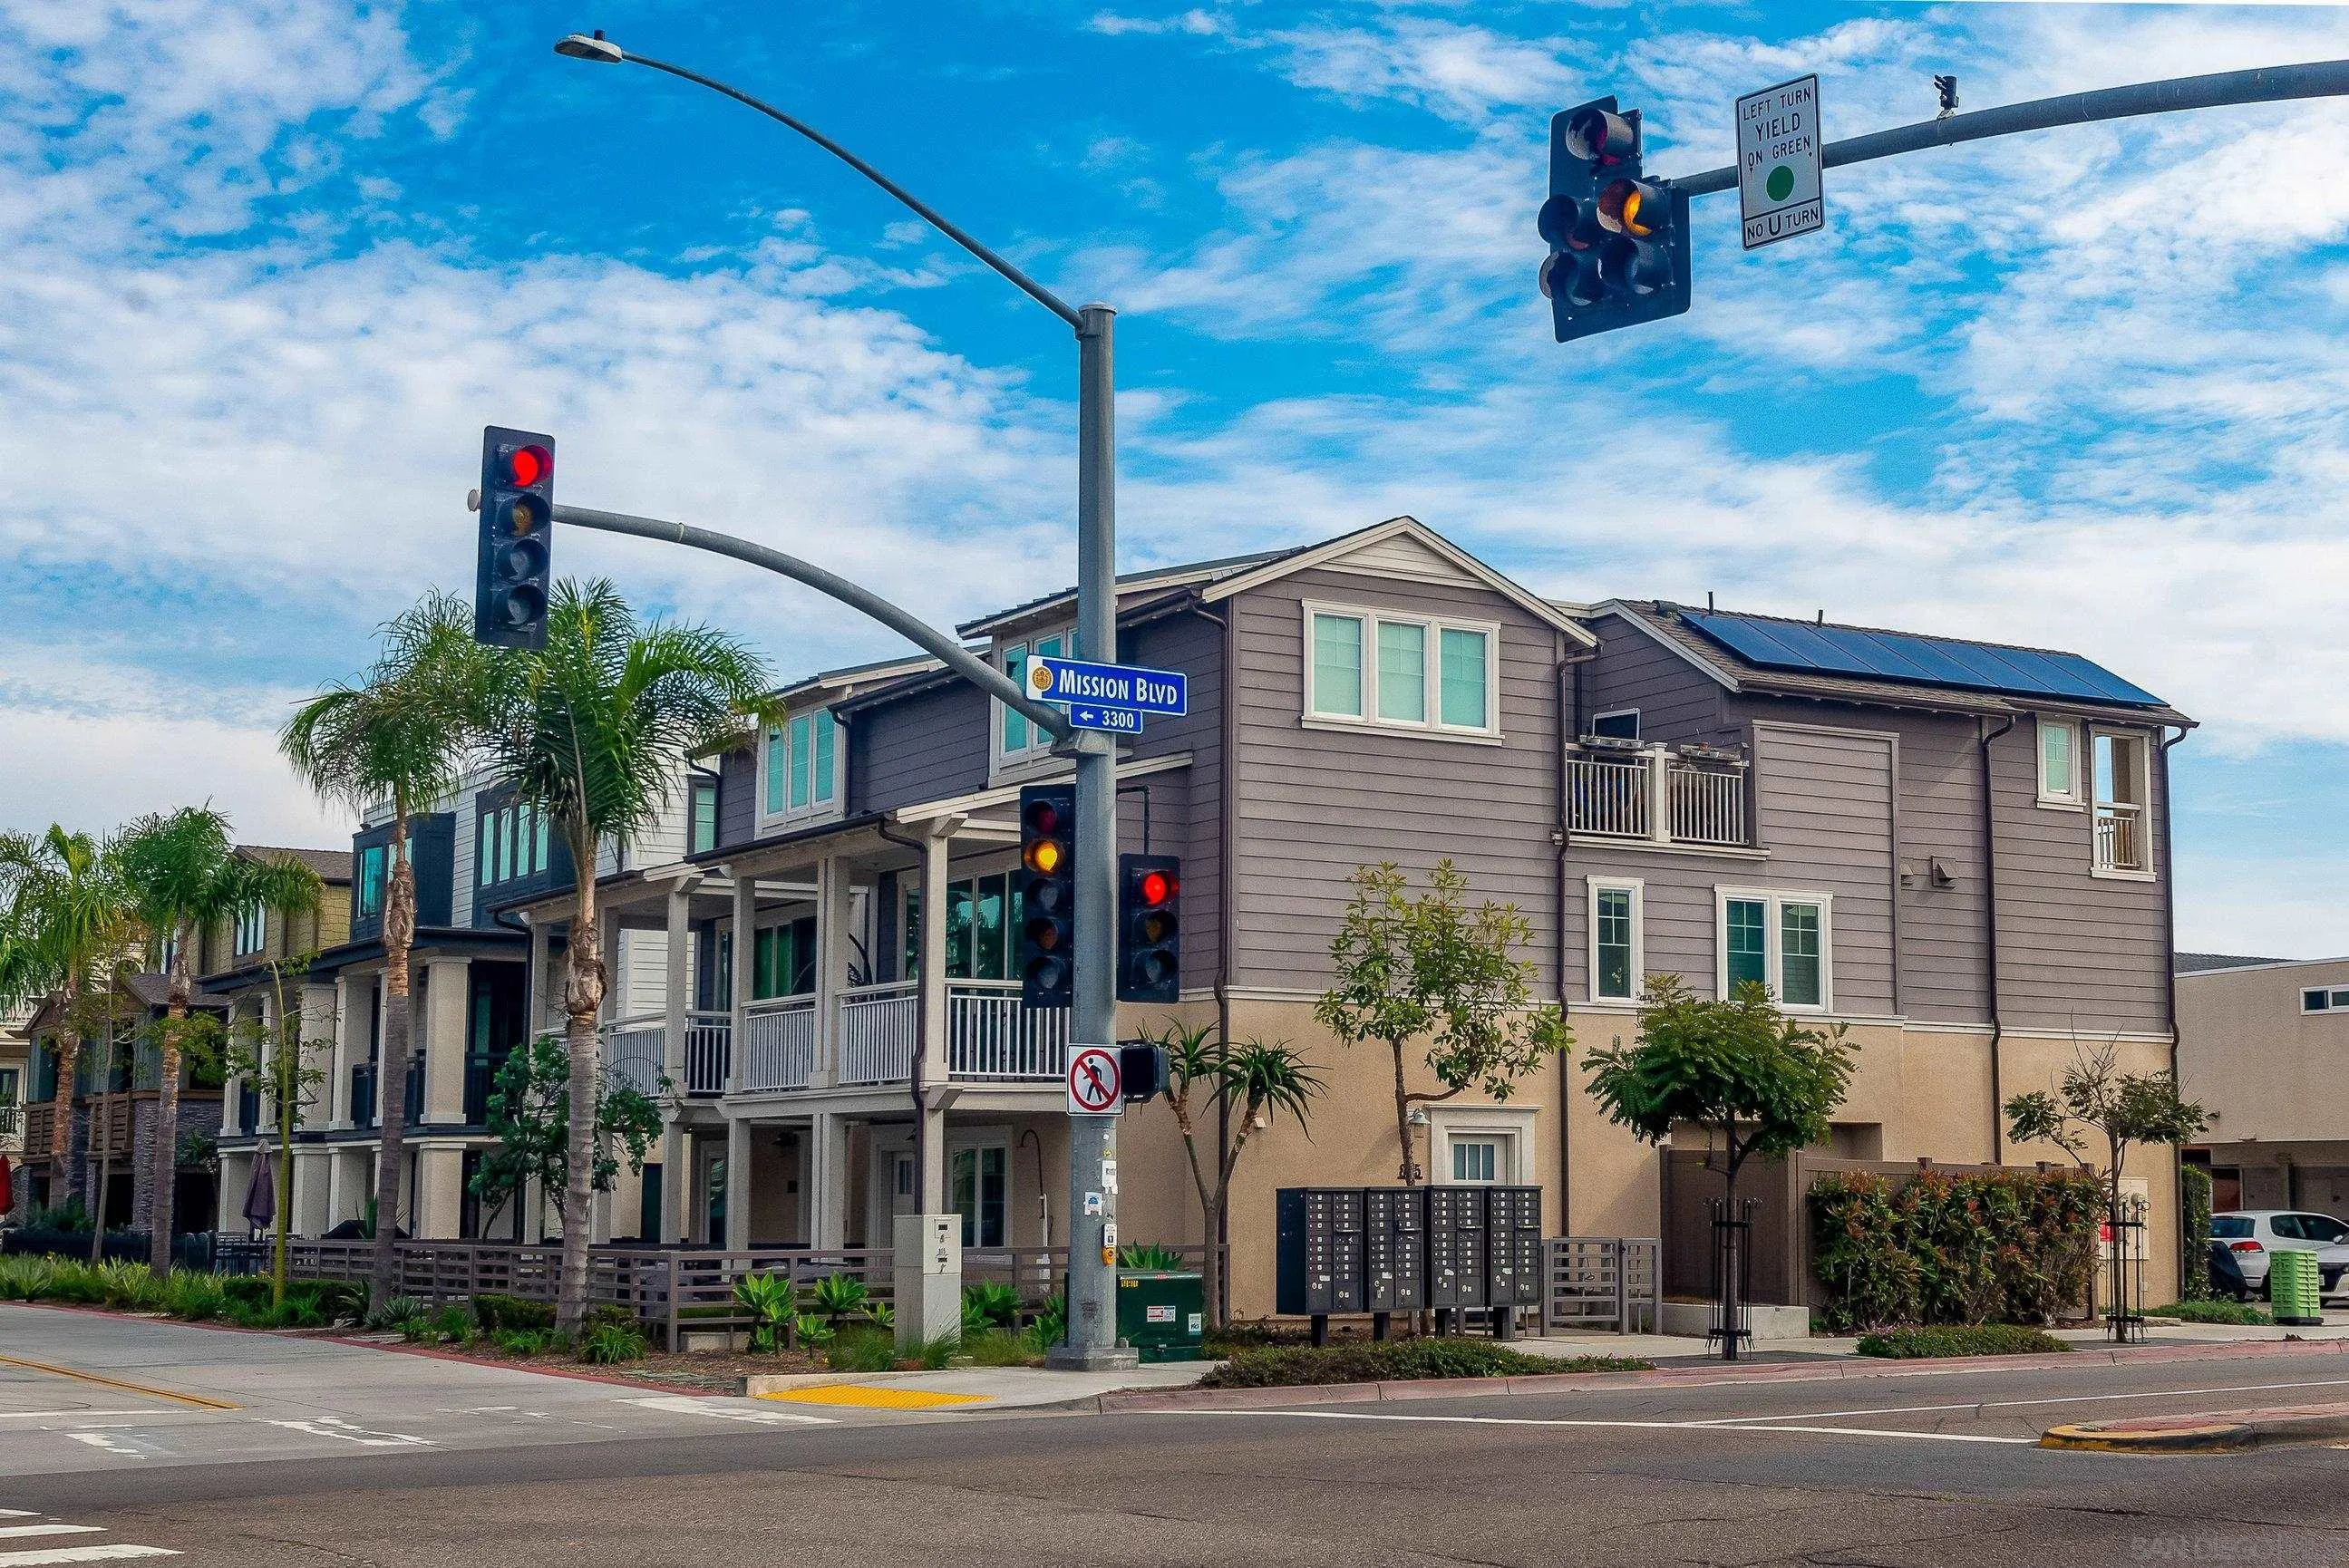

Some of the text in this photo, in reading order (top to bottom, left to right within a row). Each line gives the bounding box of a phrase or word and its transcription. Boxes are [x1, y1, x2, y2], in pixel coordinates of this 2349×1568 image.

[1742, 86, 1811, 121] LEFT TURN
[1755, 112, 1801, 142] YIELD
[1748, 135, 1810, 167] ON GREEN
[1747, 207, 1819, 239] NO U TURN
[1058, 668, 1178, 705] MISSION BLVD
[1102, 710, 1134, 729] 3300
